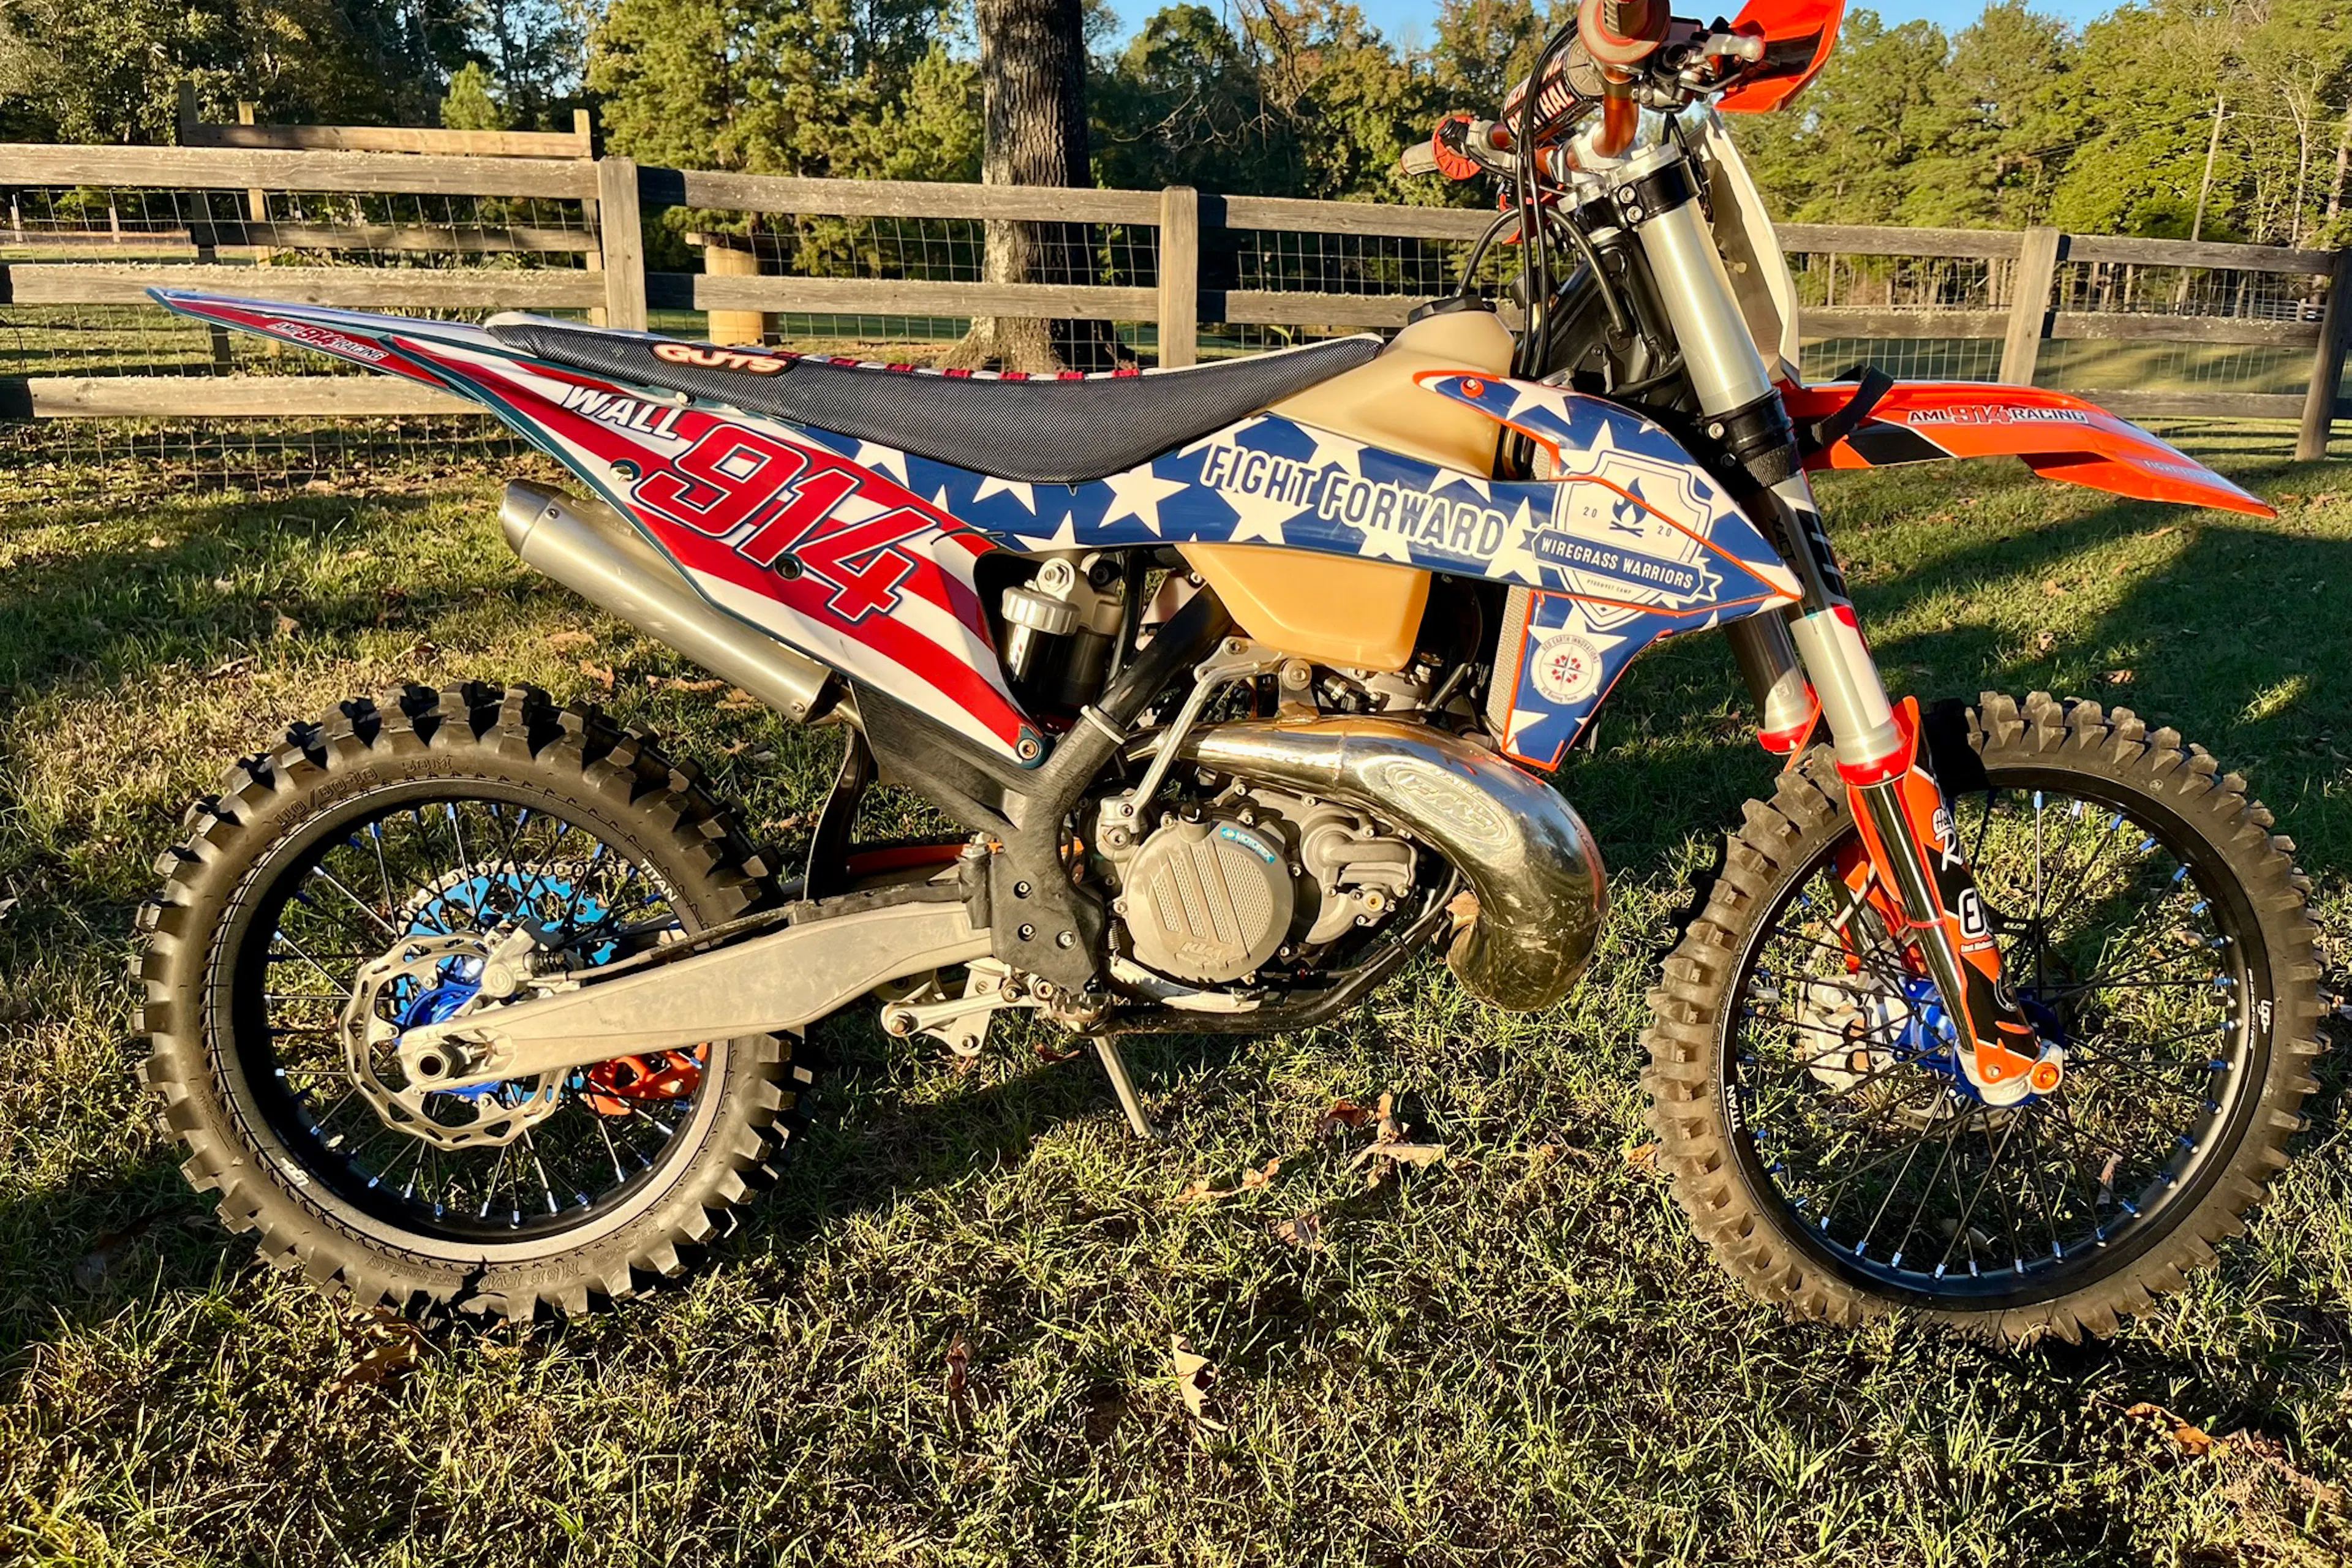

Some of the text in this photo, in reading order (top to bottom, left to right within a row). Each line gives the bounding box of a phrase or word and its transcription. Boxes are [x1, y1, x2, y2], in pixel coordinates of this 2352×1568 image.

[333, 339, 390, 361] RACING
[652, 342, 790, 372] GUTS
[564, 386, 681, 440] WALL
[1910, 405, 2086, 425] AML 914 RACING
[632, 423, 939, 624] 914
[1202, 445, 1507, 558] FIGHT FORWARD
[1540, 537, 1694, 590] WIREGRASS WARRIORS
[1235, 831, 1276, 864] MOTOREX
[639, 858, 677, 903] TITAN
[1725, 1085, 1741, 1133] TITAN
